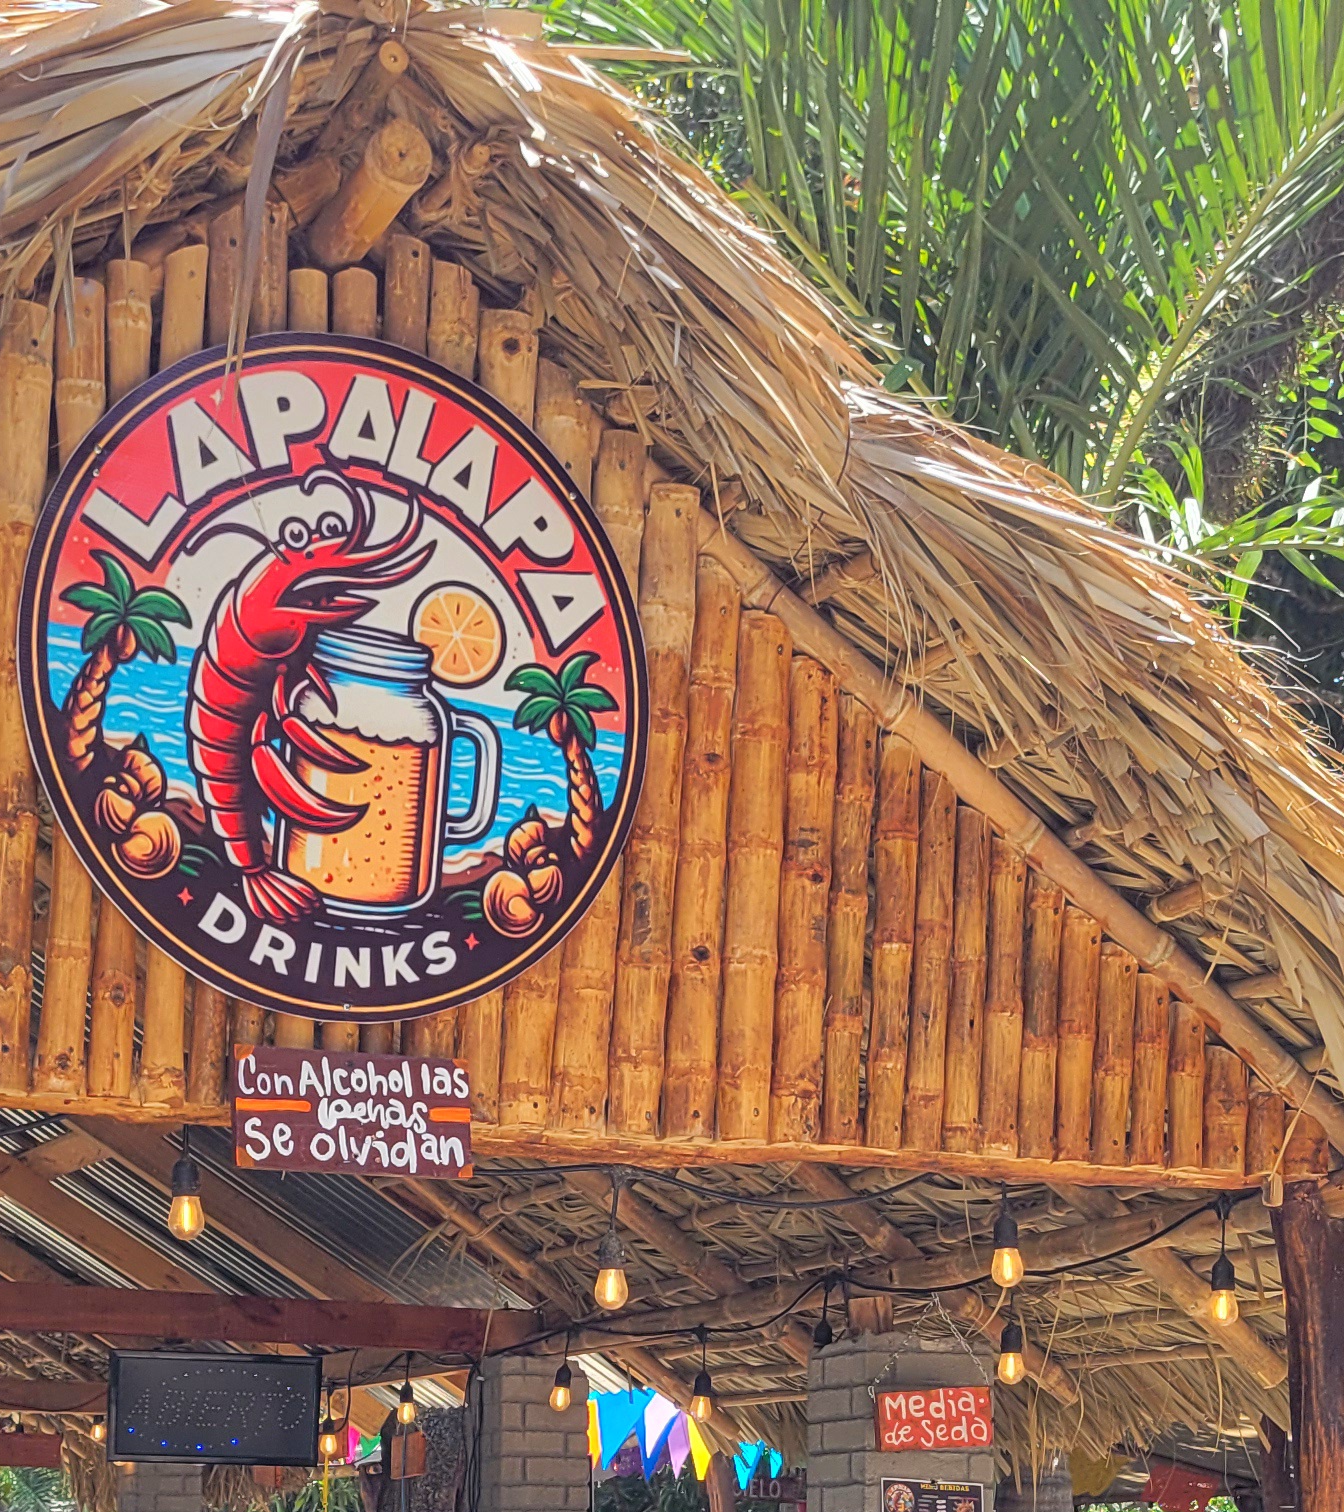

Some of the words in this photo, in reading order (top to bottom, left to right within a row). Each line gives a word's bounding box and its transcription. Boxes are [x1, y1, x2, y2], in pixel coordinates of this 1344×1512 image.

[197, 891, 458, 990] DRINKS
[238, 1054, 294, 1095] Con
[299, 1056, 413, 1097] Alcohol
[421, 1063, 469, 1098] las
[244, 1117, 294, 1160] Se
[309, 1125, 465, 1173] olvidan
[884, 1422, 914, 1445] de
[920, 1416, 988, 1448] Seda
